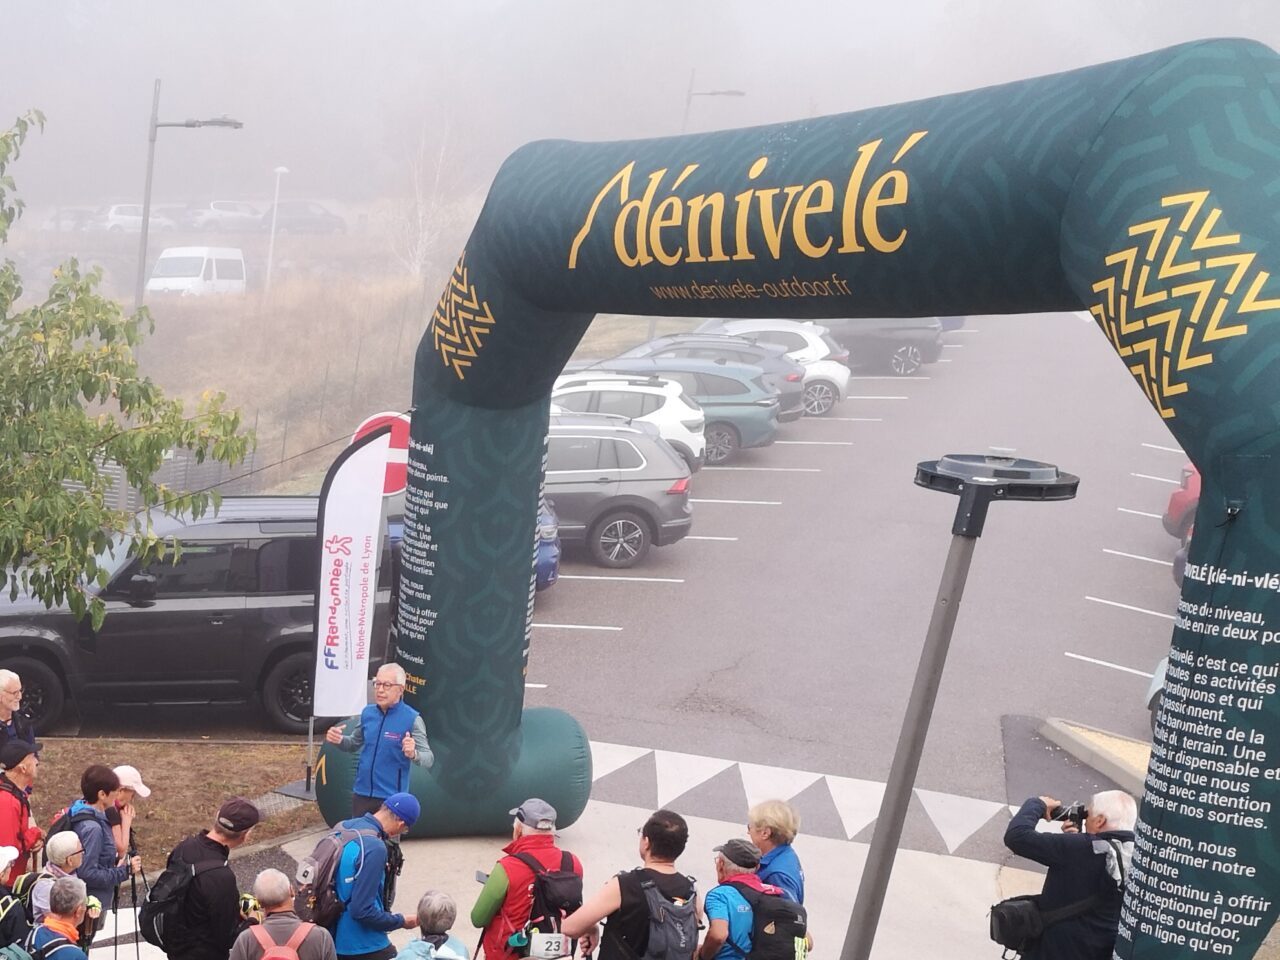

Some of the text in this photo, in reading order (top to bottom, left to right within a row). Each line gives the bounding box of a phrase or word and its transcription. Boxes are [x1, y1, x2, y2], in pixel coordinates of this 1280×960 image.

[613, 131, 929, 268] dénivelé
[649, 273, 853, 300] www.denivele-outdoor.fr
[426, 473, 450, 483] points.
[434, 501, 448, 510] que
[419, 532, 431, 541] Une
[430, 543, 438, 551] et
[355, 535, 373, 661] Rhône-Métropole de Lyon
[419, 617, 435, 626] pour
[421, 609, 438, 618] offrir
[1214, 605, 1265, 626] niveau,
[1222, 623, 1257, 641] deux
[1197, 655, 1227, 672] c'est
[1229, 661, 1248, 674] ce
[1251, 662, 1279, 678] qui
[1210, 675, 1277, 695] activités
[1218, 694, 1233, 707] et
[1236, 696, 1264, 711] qui
[1225, 726, 1246, 742] de
[1249, 729, 1265, 745] la
[1182, 736, 1228, 757] terrain.
[1232, 744, 1267, 762] Une
[1183, 772, 1208, 787] que
[1210, 776, 1251, 793] nous
[1263, 767, 1280, 781] et
[1169, 784, 1196, 801] avec
[1198, 790, 1271, 814] attention
[1179, 803, 1205, 819] nos
[1207, 809, 1269, 829] sorties.
[1152, 828, 1164, 841] ce
[1164, 832, 1195, 852] nom,
[1197, 840, 1237, 858] nous
[1150, 860, 1179, 879] notre
[1158, 845, 1210, 869] affirmer
[1212, 859, 1257, 877] notre
[1159, 879, 1210, 903] continu
[1213, 890, 1224, 905] à
[1228, 894, 1272, 912] offrir
[1220, 910, 1263, 927] pour
[1140, 921, 1153, 936] en
[1155, 924, 1186, 945] ligne
[1189, 936, 1234, 956] qu'en
[1177, 917, 1241, 943] outdoor,
[544, 940, 561, 952] 23
